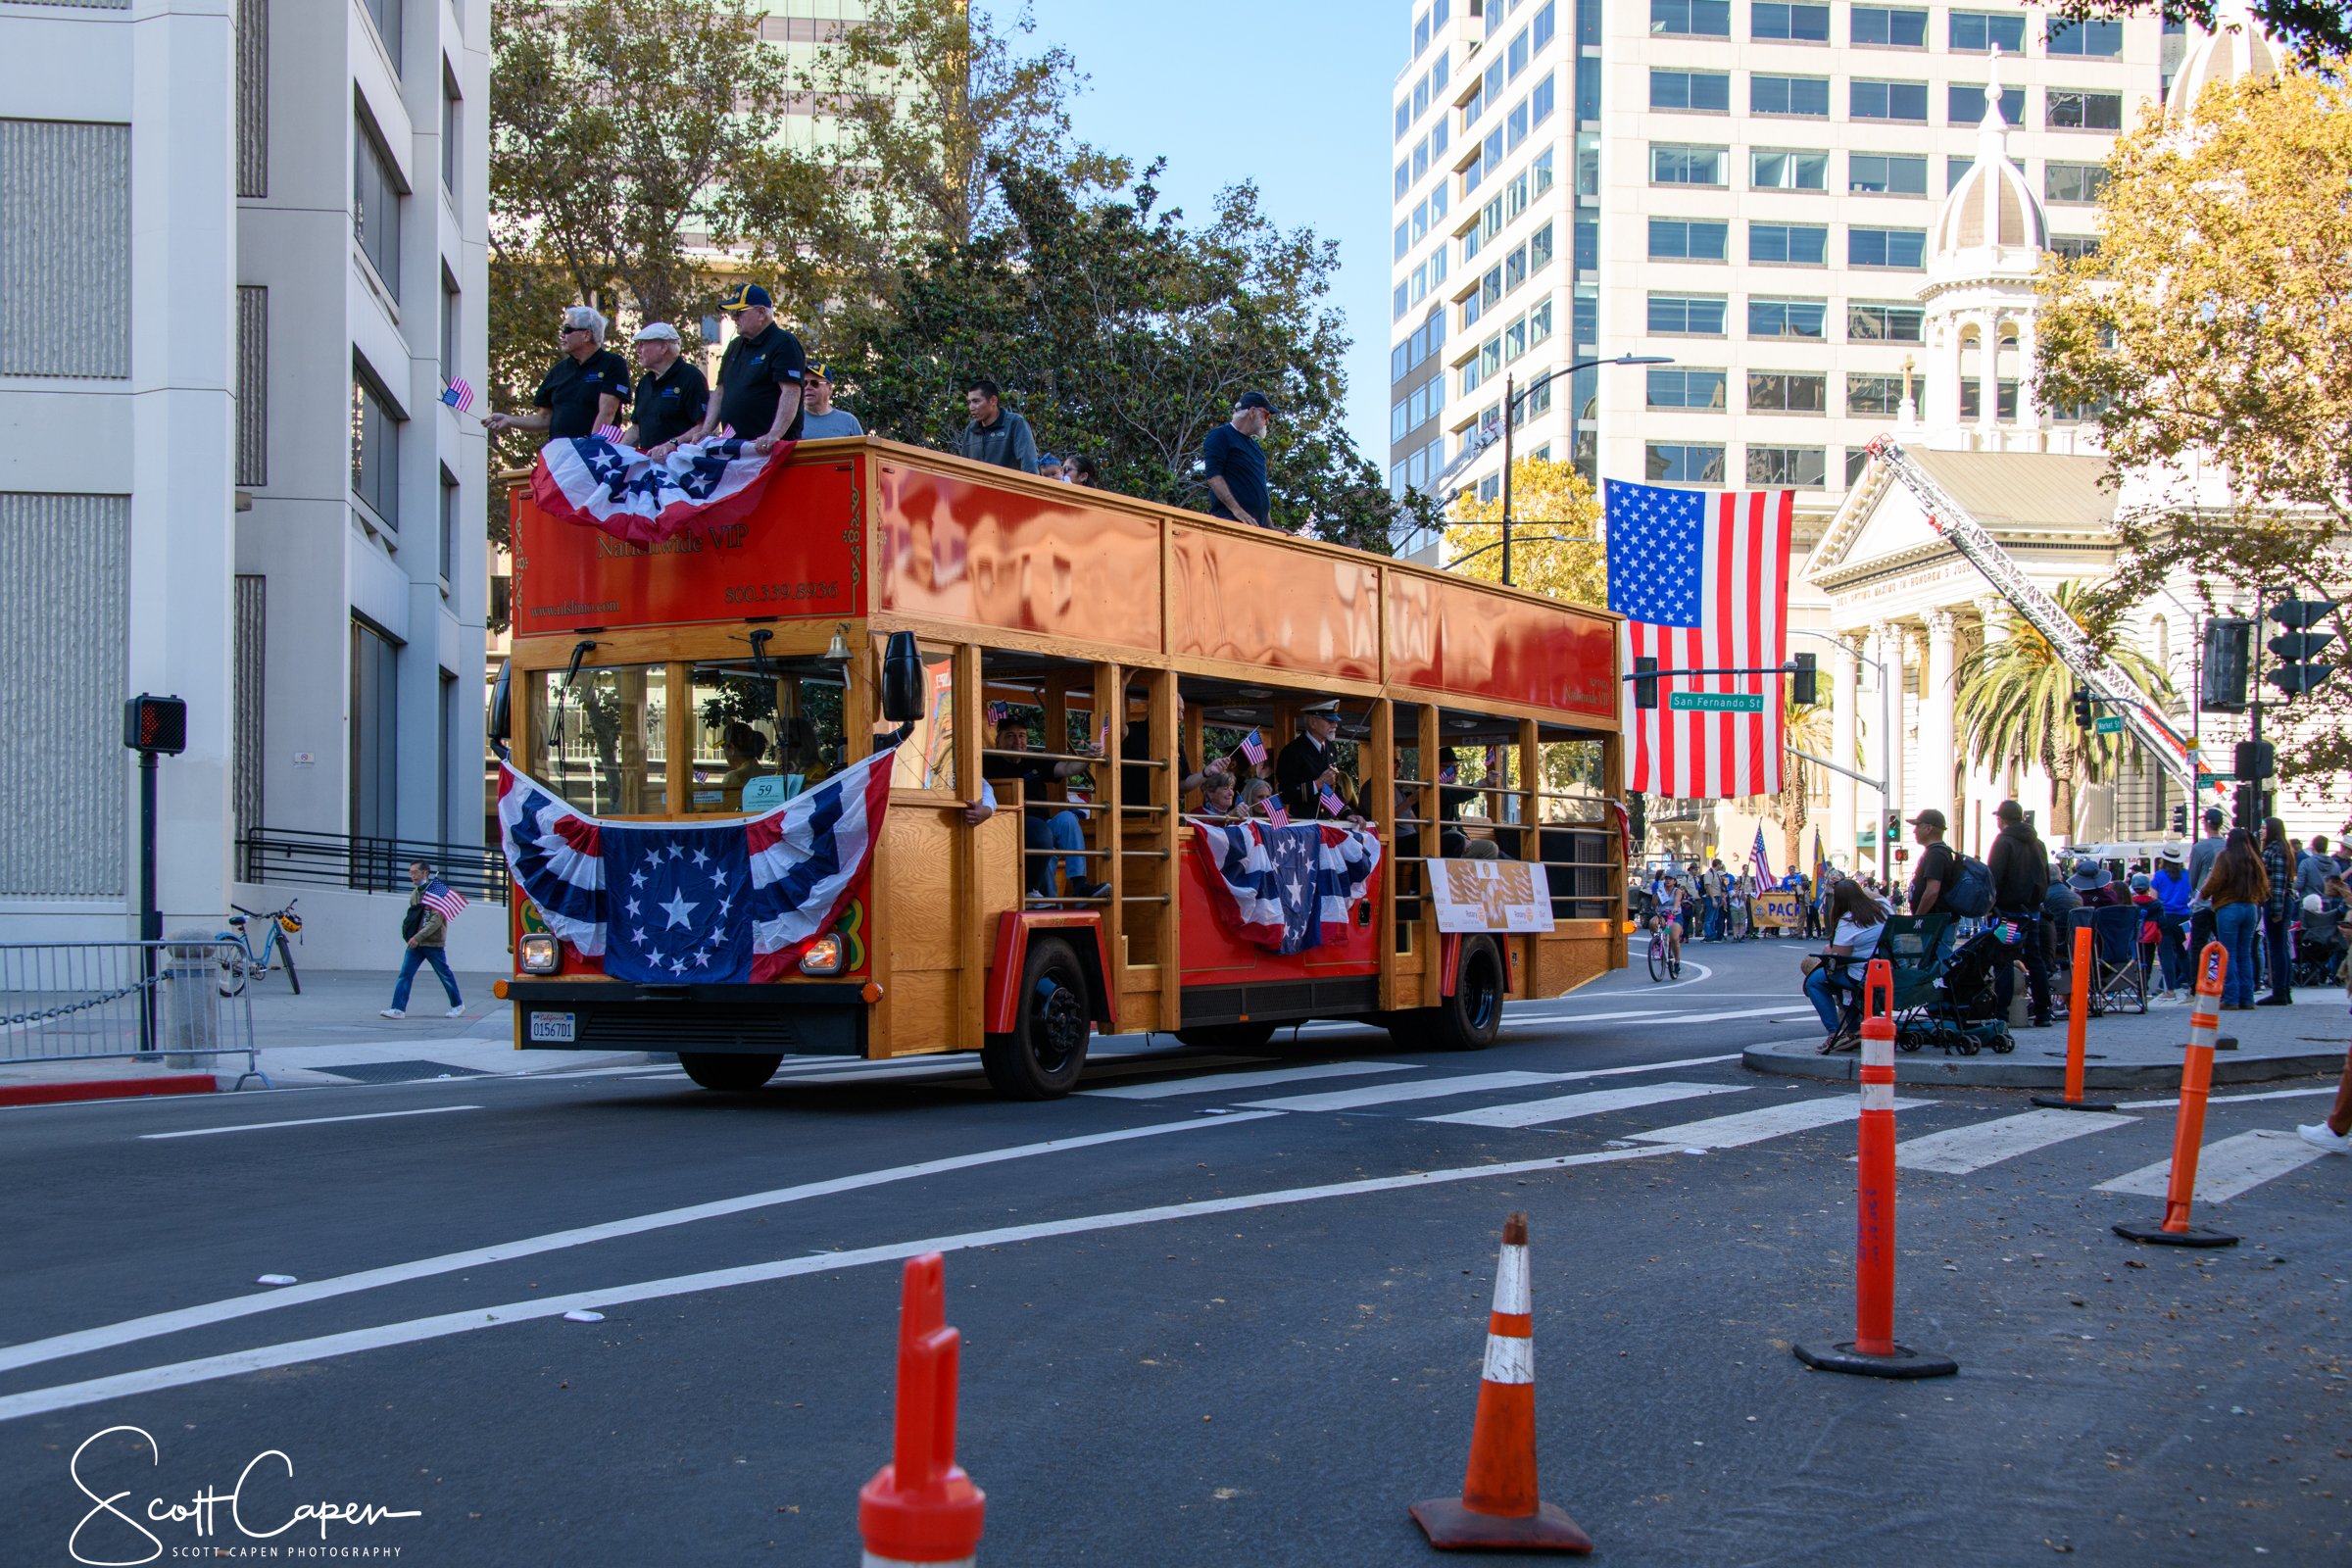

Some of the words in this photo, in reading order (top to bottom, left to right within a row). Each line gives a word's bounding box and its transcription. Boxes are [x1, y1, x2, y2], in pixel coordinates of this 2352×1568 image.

[708, 524, 749, 550] VIP
[724, 580, 839, 605] 800.339.8936
[1674, 696, 1692, 707] San
[1696, 697, 1744, 708] Fernando
[1749, 698, 1761, 709] St
[2098, 721, 2113, 730] Market
[2114, 719, 2121, 729] St
[757, 784, 773, 797] 59
[533, 1022, 572, 1037] 01567D1
